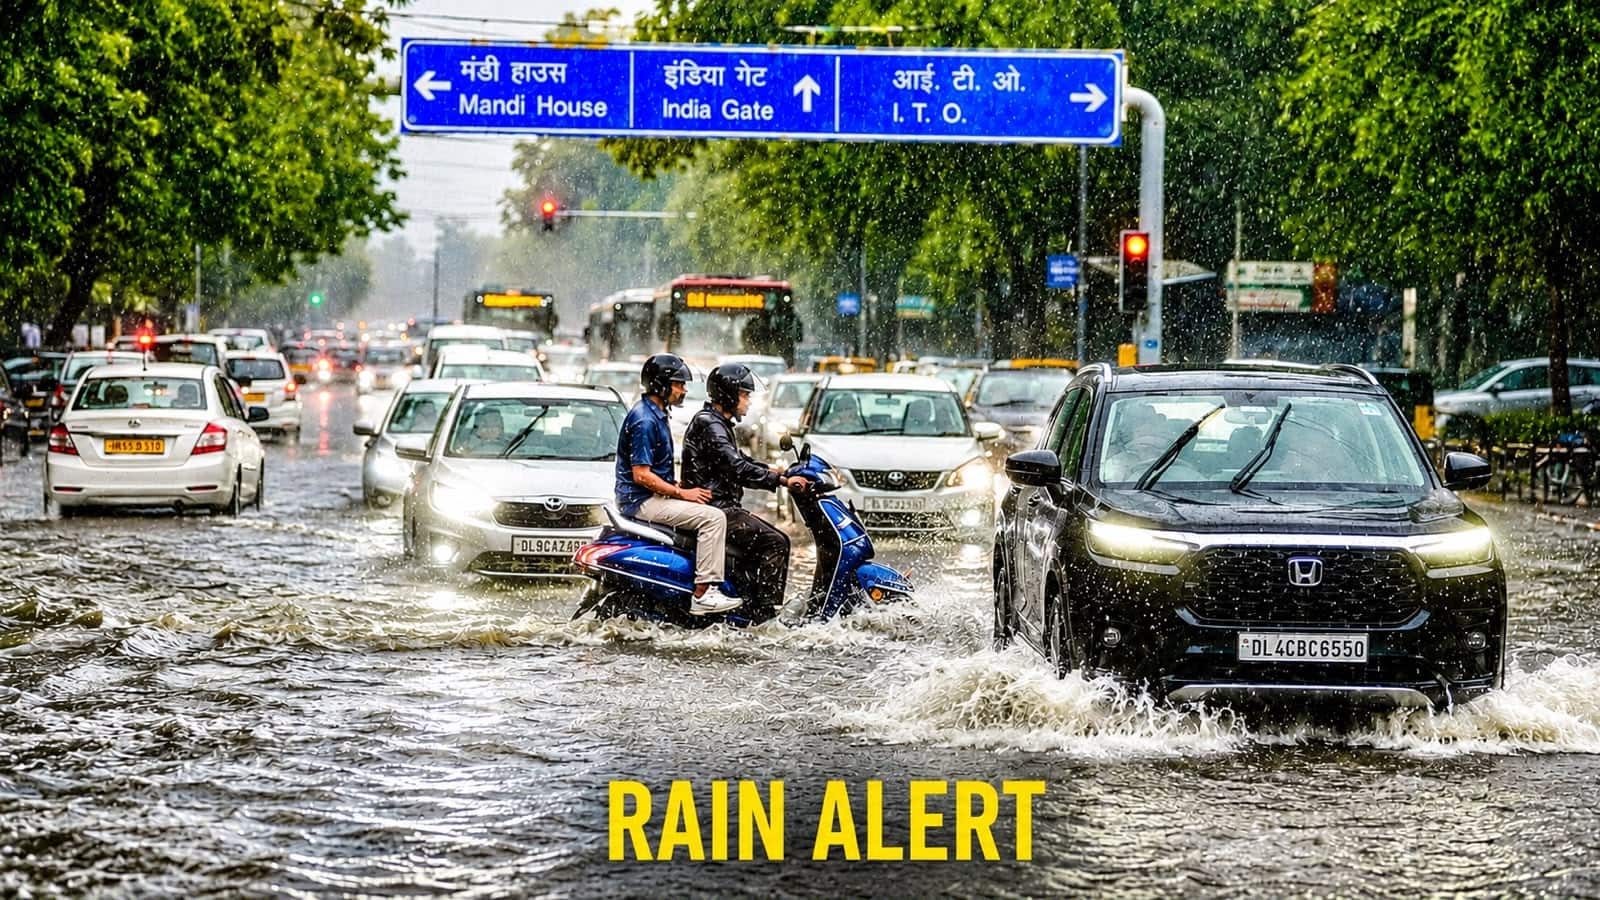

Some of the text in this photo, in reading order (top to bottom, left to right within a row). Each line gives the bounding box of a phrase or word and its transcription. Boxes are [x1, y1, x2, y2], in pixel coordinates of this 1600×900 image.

[460, 55, 567, 84] मंडी हाउस
[663, 58, 768, 90] इंडिया गेट
[892, 63, 1026, 94] आई. टी. ओ.
[459, 94, 608, 117] Mandi House
[663, 98, 774, 121] India Gate
[893, 102, 967, 123] I. T. O.
[1252, 639, 1364, 657] DL4CBC6550
